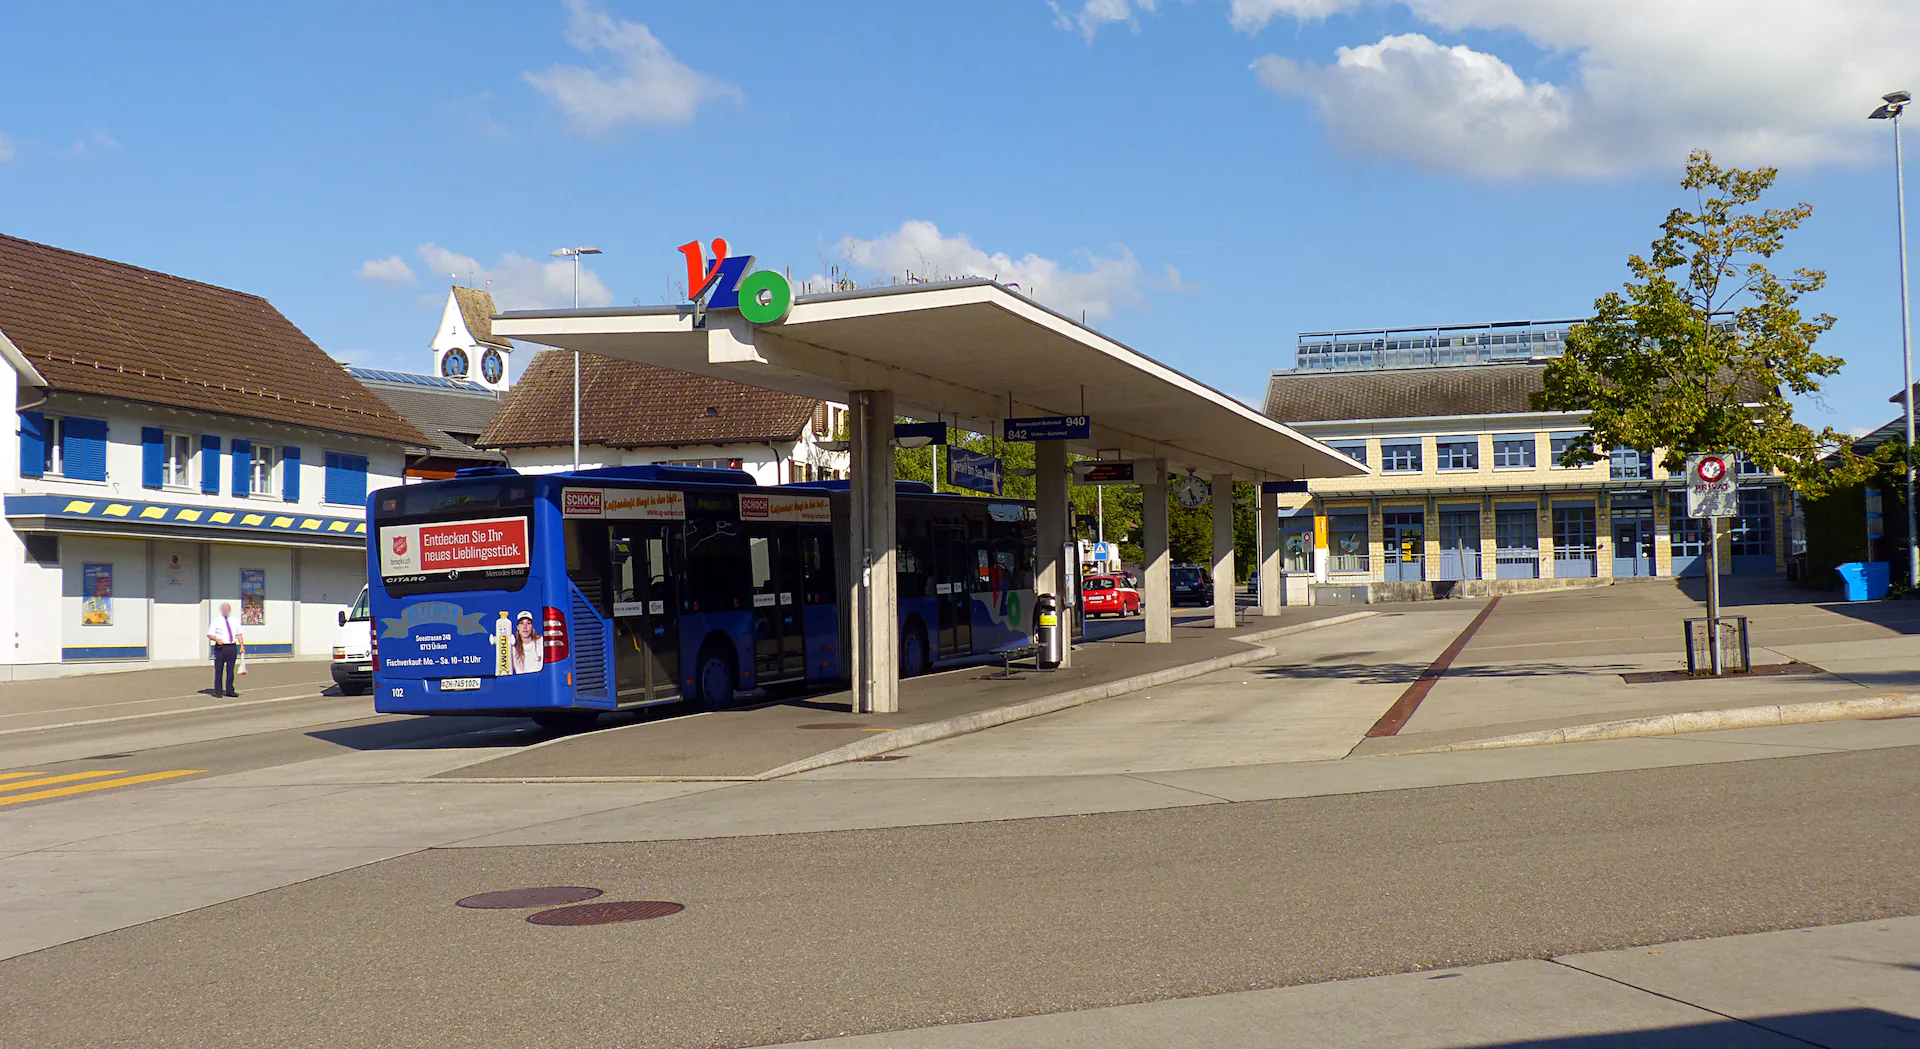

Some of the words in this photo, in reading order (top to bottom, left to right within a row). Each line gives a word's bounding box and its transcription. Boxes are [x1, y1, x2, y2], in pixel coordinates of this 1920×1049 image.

[677, 237, 795, 324] VZO
[1066, 416, 1086, 426] 940
[1008, 430, 1027, 439] 842
[566, 494, 600, 506] SCHOCH
[636, 496, 649, 508] liegt
[650, 496, 656, 504] in
[657, 494, 666, 503] der
[742, 500, 768, 510] SCHOCH
[424, 532, 470, 546] Entdecken
[472, 530, 486, 544] Sie
[488, 528, 504, 542] Ihr
[424, 549, 451, 562] neues
[452, 543, 521, 561] Lieblingsstück.
[486, 569, 524, 577] Mercedes-Benz
[386, 658, 422, 666] Fischverkauf:
[440, 657, 450, 665] Sa.
[392, 688, 404, 697] 102
